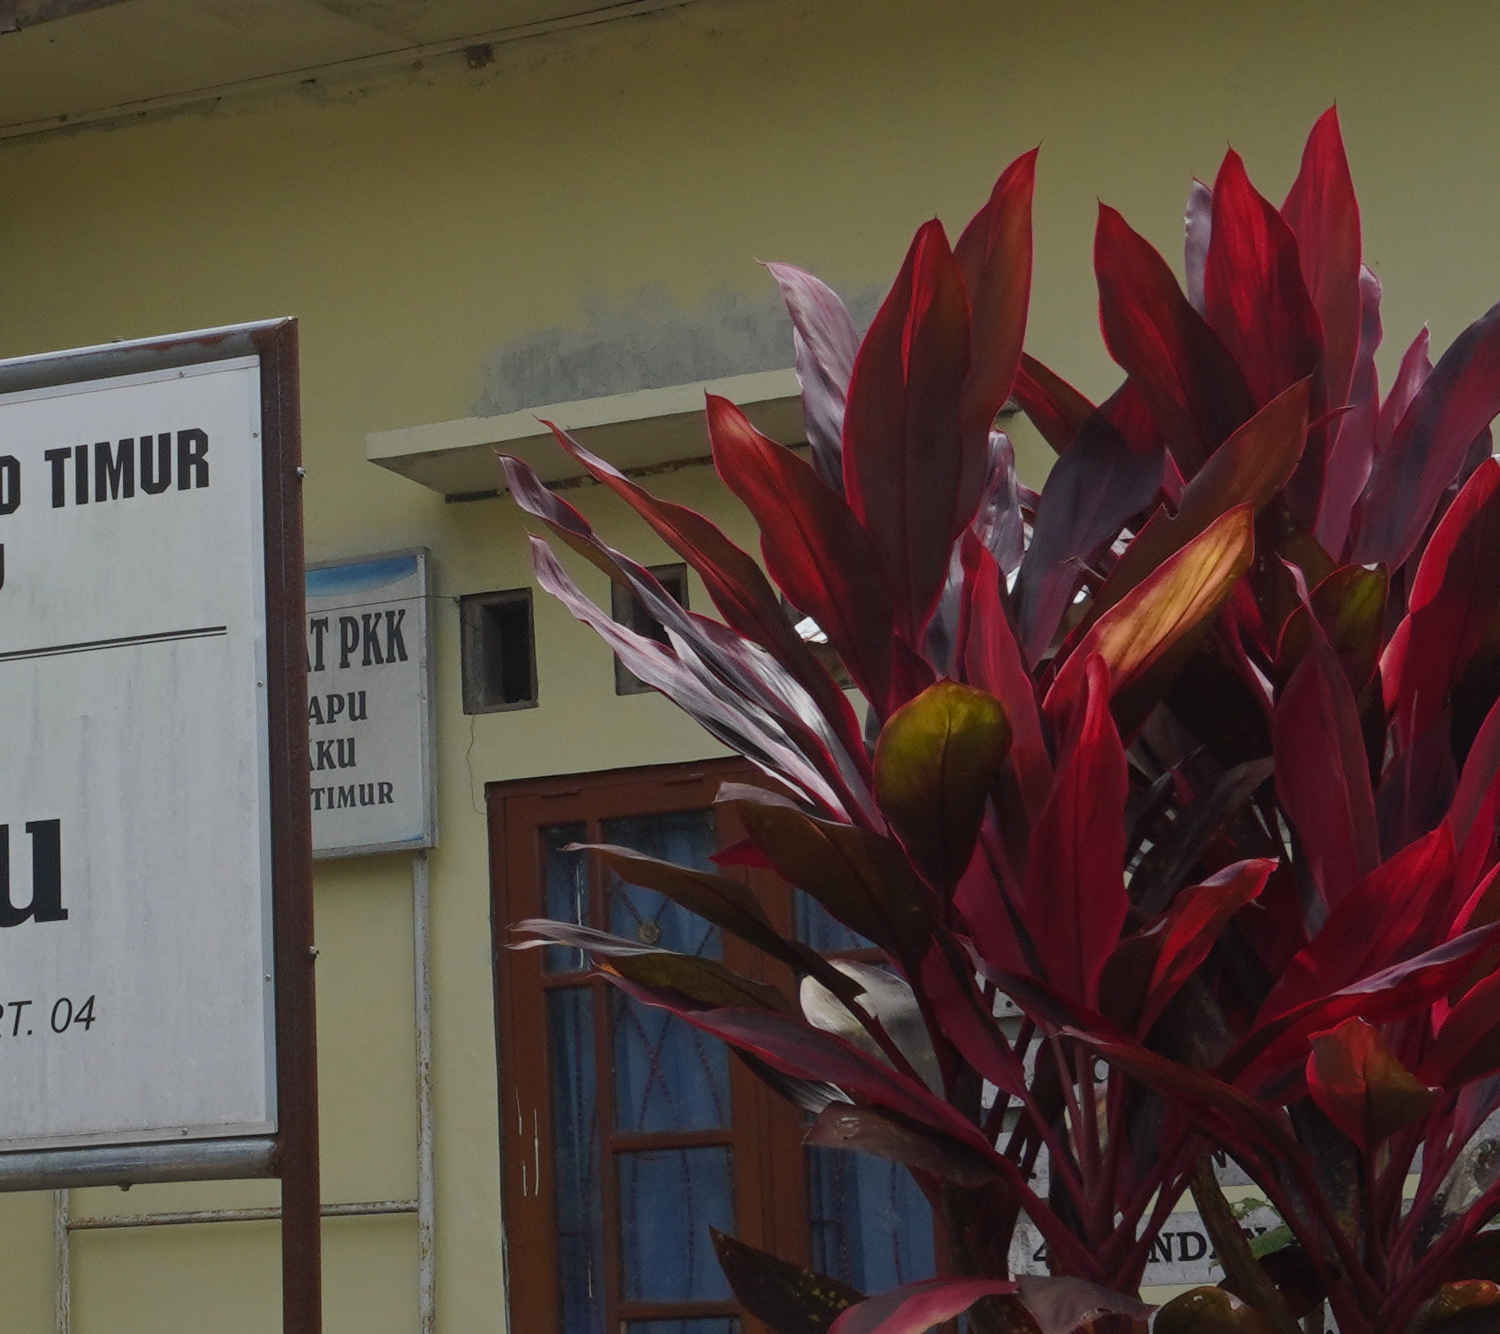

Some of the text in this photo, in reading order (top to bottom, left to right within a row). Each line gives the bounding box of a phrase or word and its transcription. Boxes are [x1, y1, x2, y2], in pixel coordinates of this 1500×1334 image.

[44, 427, 210, 509] TIMUR
[339, 609, 409, 669] PKK
[307, 690, 368, 726] APU
[309, 737, 356, 772] KU
[310, 781, 395, 811] TIMUR
[50, 994, 96, 1034] 04
